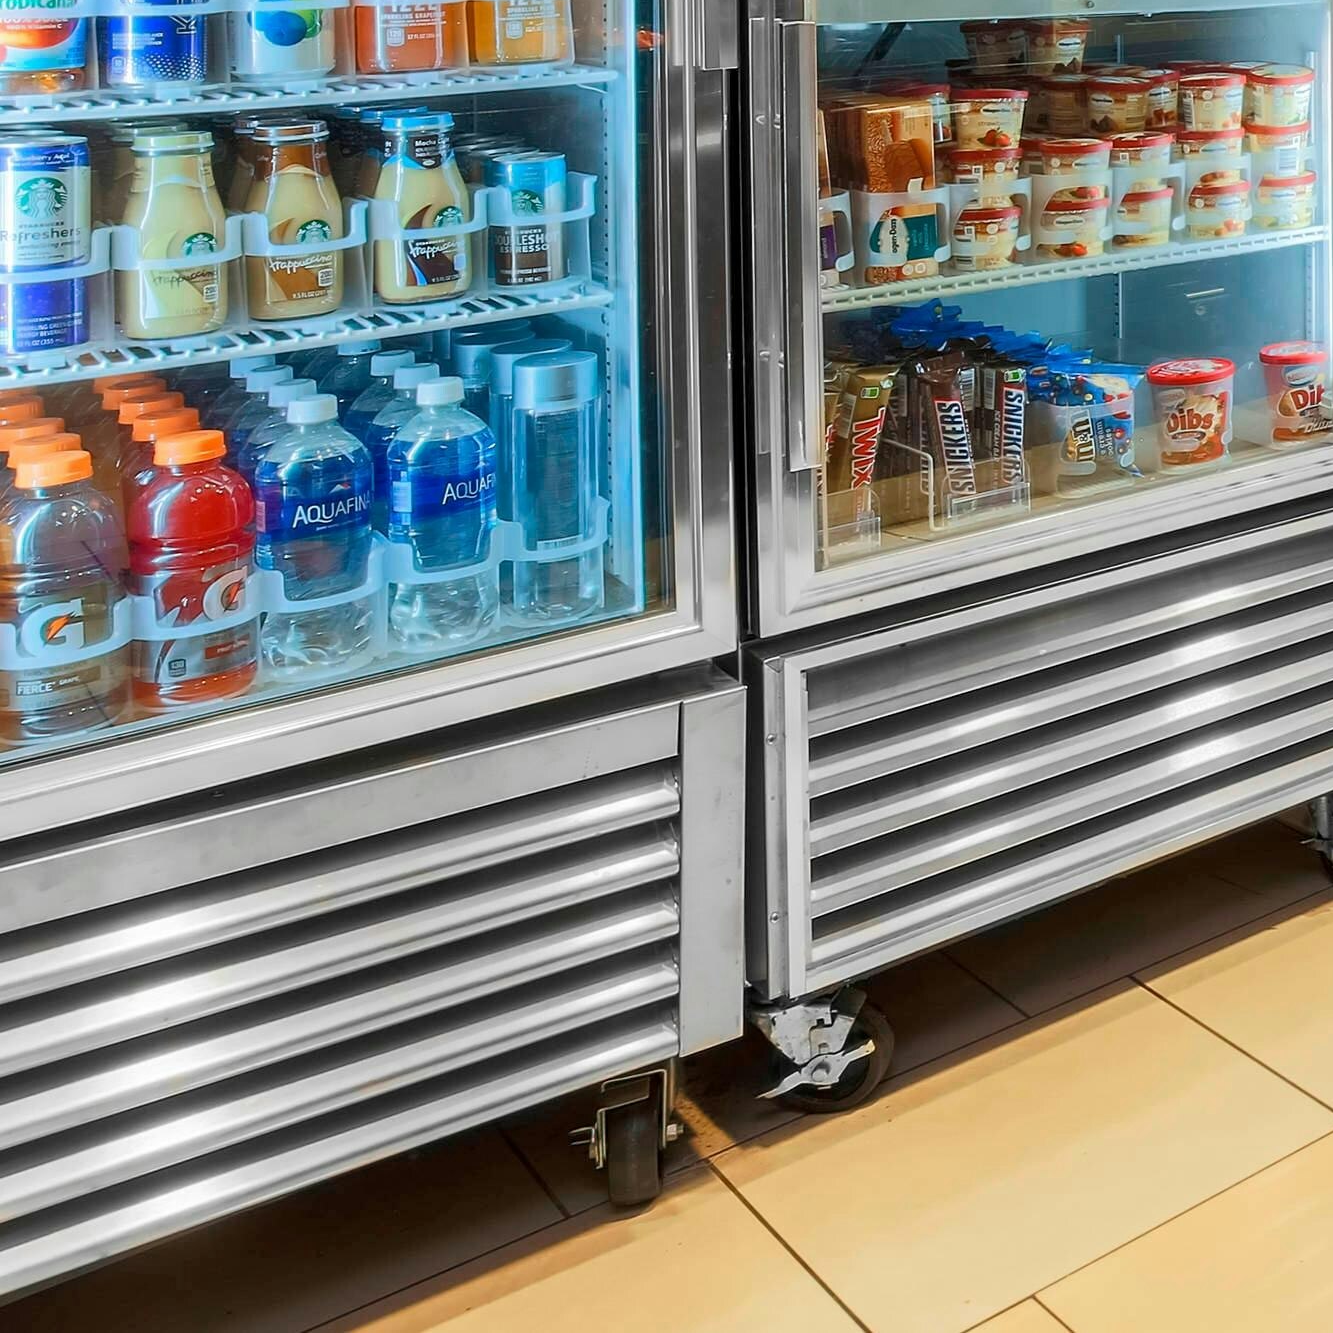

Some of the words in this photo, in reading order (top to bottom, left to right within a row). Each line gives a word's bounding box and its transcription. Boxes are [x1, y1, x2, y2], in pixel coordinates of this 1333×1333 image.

[414, 139, 437, 147] Mocha
[852, 406, 886, 490] TWIX
[937, 400, 976, 495] SNICKERS
[1002, 389, 1026, 485] SNICKERS
[442, 472, 497, 505] AQUAFI
[292, 492, 371, 528] AQUAFINA
[17, 682, 53, 696] FIERCE
